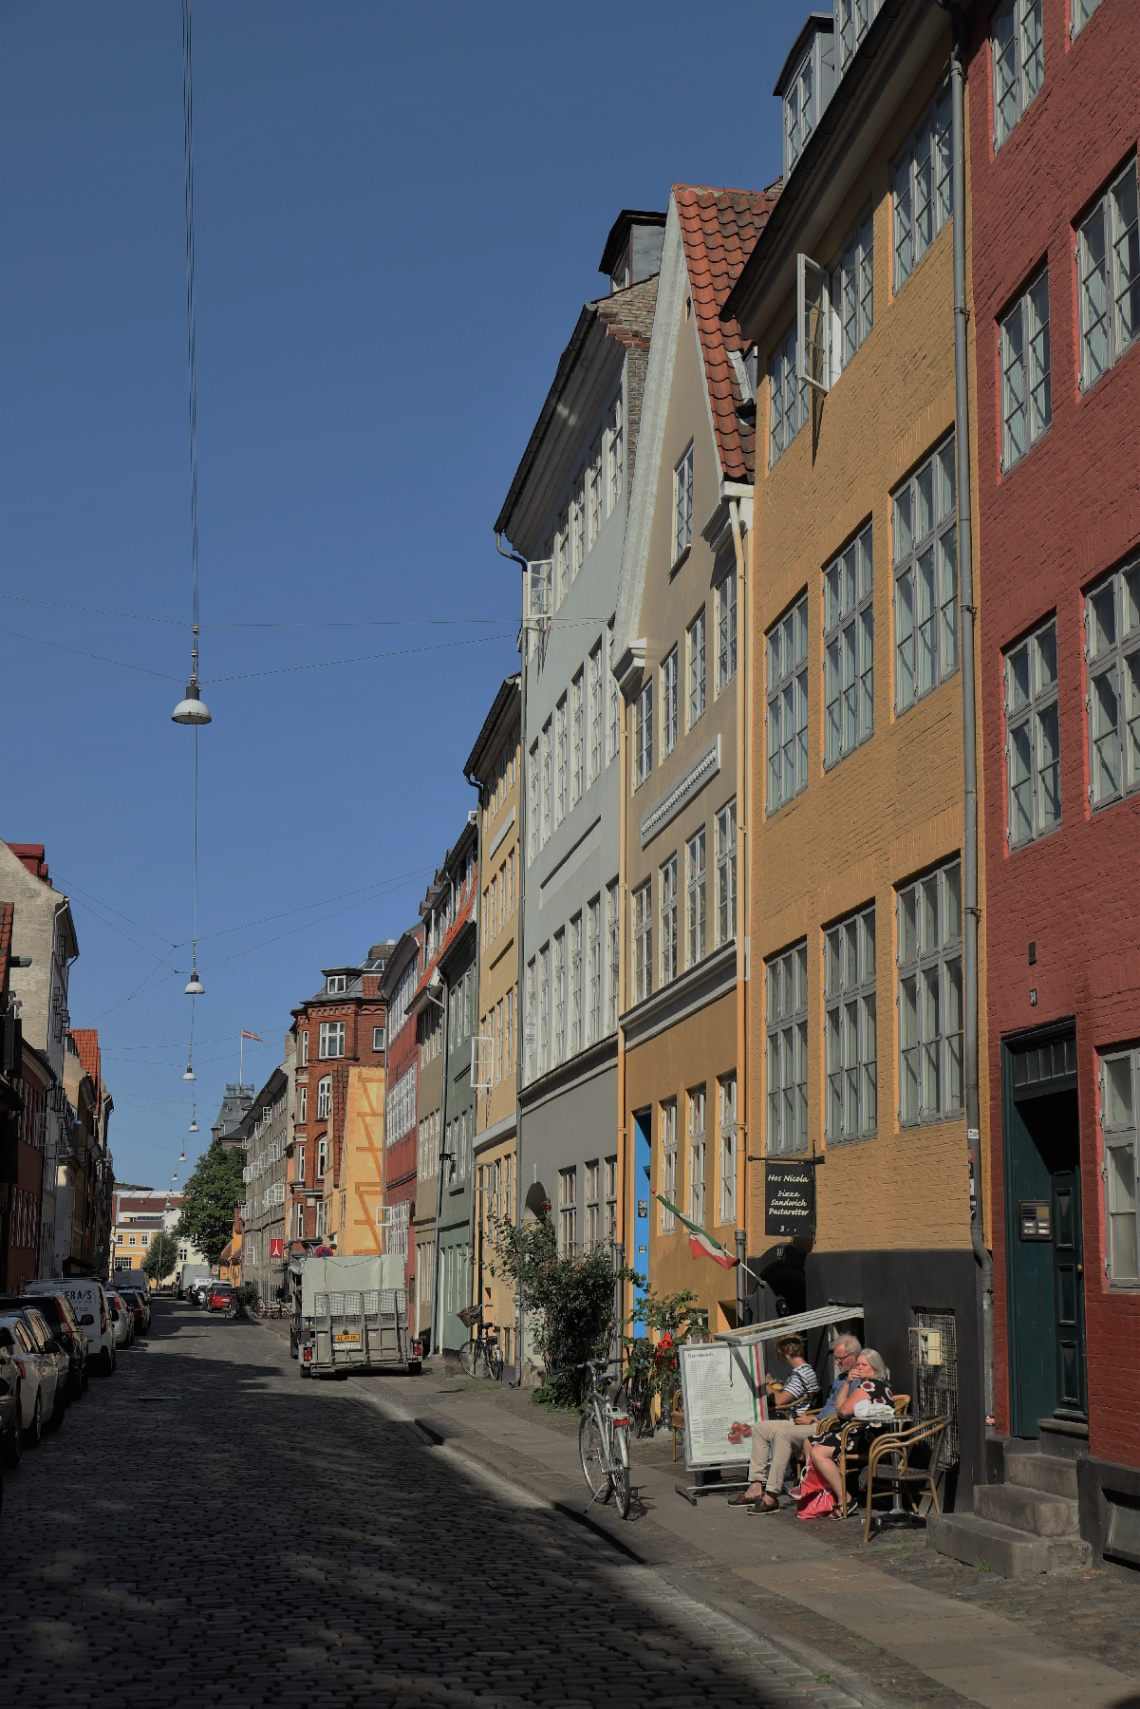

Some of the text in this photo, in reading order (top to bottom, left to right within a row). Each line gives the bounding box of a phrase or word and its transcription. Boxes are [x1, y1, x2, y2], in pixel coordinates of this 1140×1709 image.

[783, 1174, 809, 1183] Nicola
[770, 1198, 808, 1207] Sandwich
[77, 1290, 92, 1300] A/S
